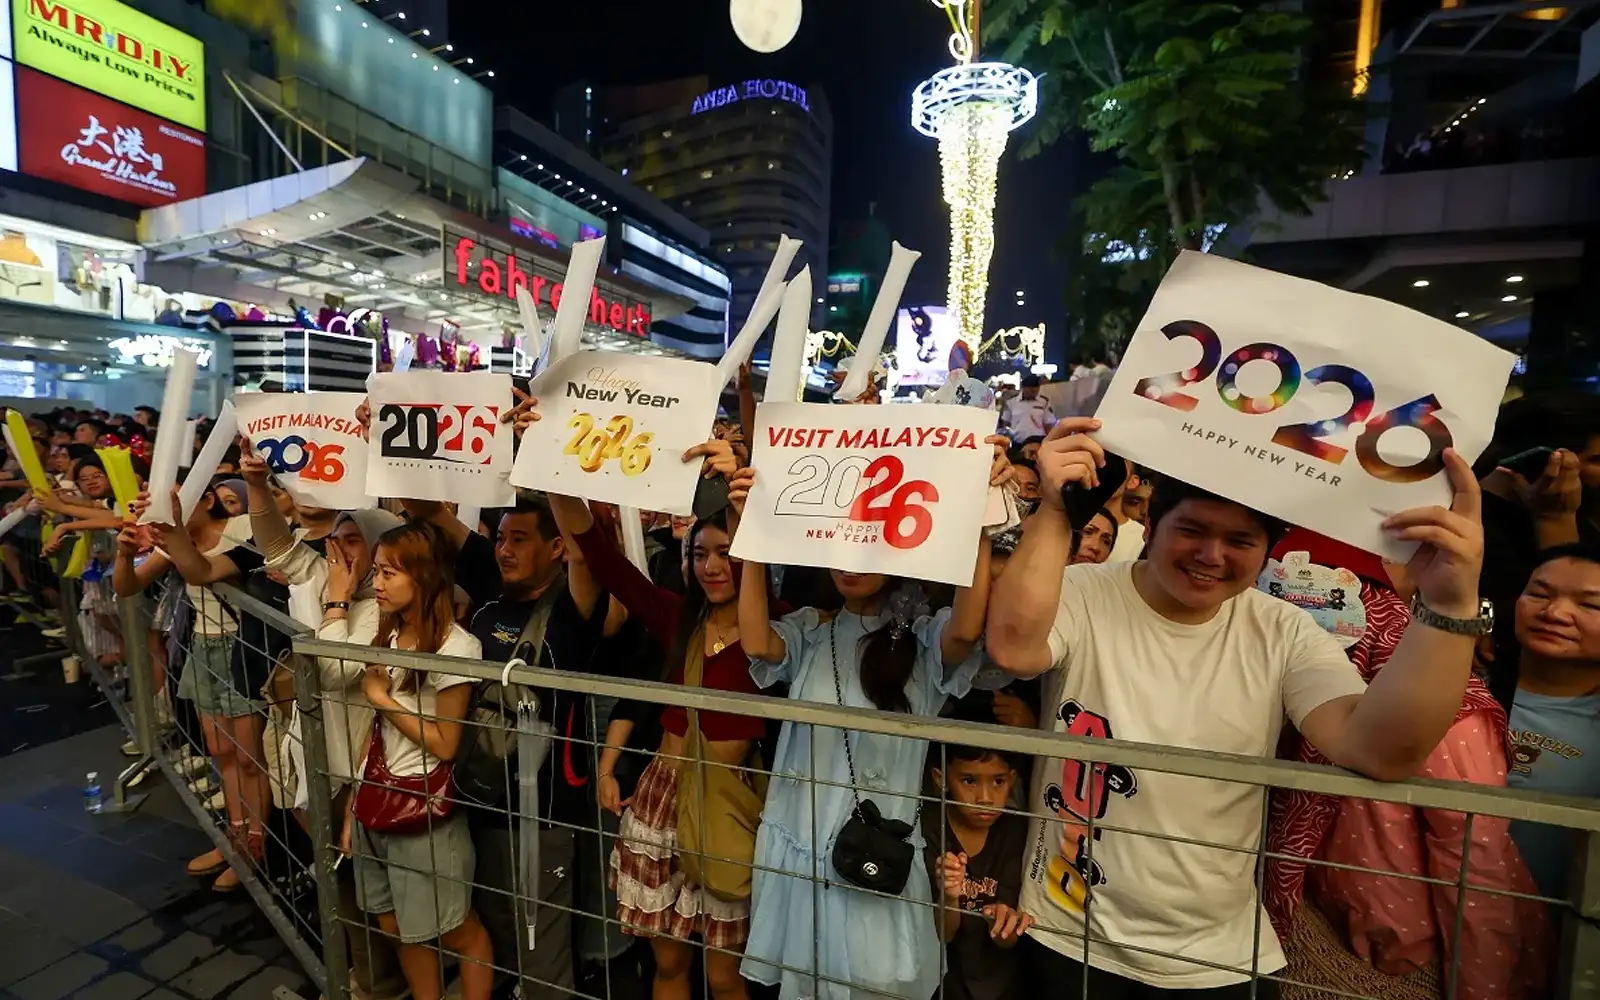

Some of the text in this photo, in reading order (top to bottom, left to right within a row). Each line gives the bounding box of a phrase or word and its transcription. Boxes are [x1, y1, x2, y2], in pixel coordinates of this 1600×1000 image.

[28, 25, 196, 101] Always Low Prices
[691, 84, 738, 115] ANSA
[455, 237, 650, 336] fahreheit
[566, 381, 680, 408] New Year
[586, 365, 642, 392] Happy
[1133, 319, 1454, 483] 2026
[247, 412, 364, 439] VISIT MALAYSIA
[379, 404, 499, 465] 2026
[562, 412, 656, 478] 2026
[768, 426, 978, 450] VISIT MALAYSIA
[256, 434, 346, 484] 2026
[1181, 421, 1343, 488] HAPPY NEW YEAR
[774, 453, 940, 549] 2026
[805, 529, 878, 543] NEW YEAR
[835, 521, 880, 534] HAPPY
